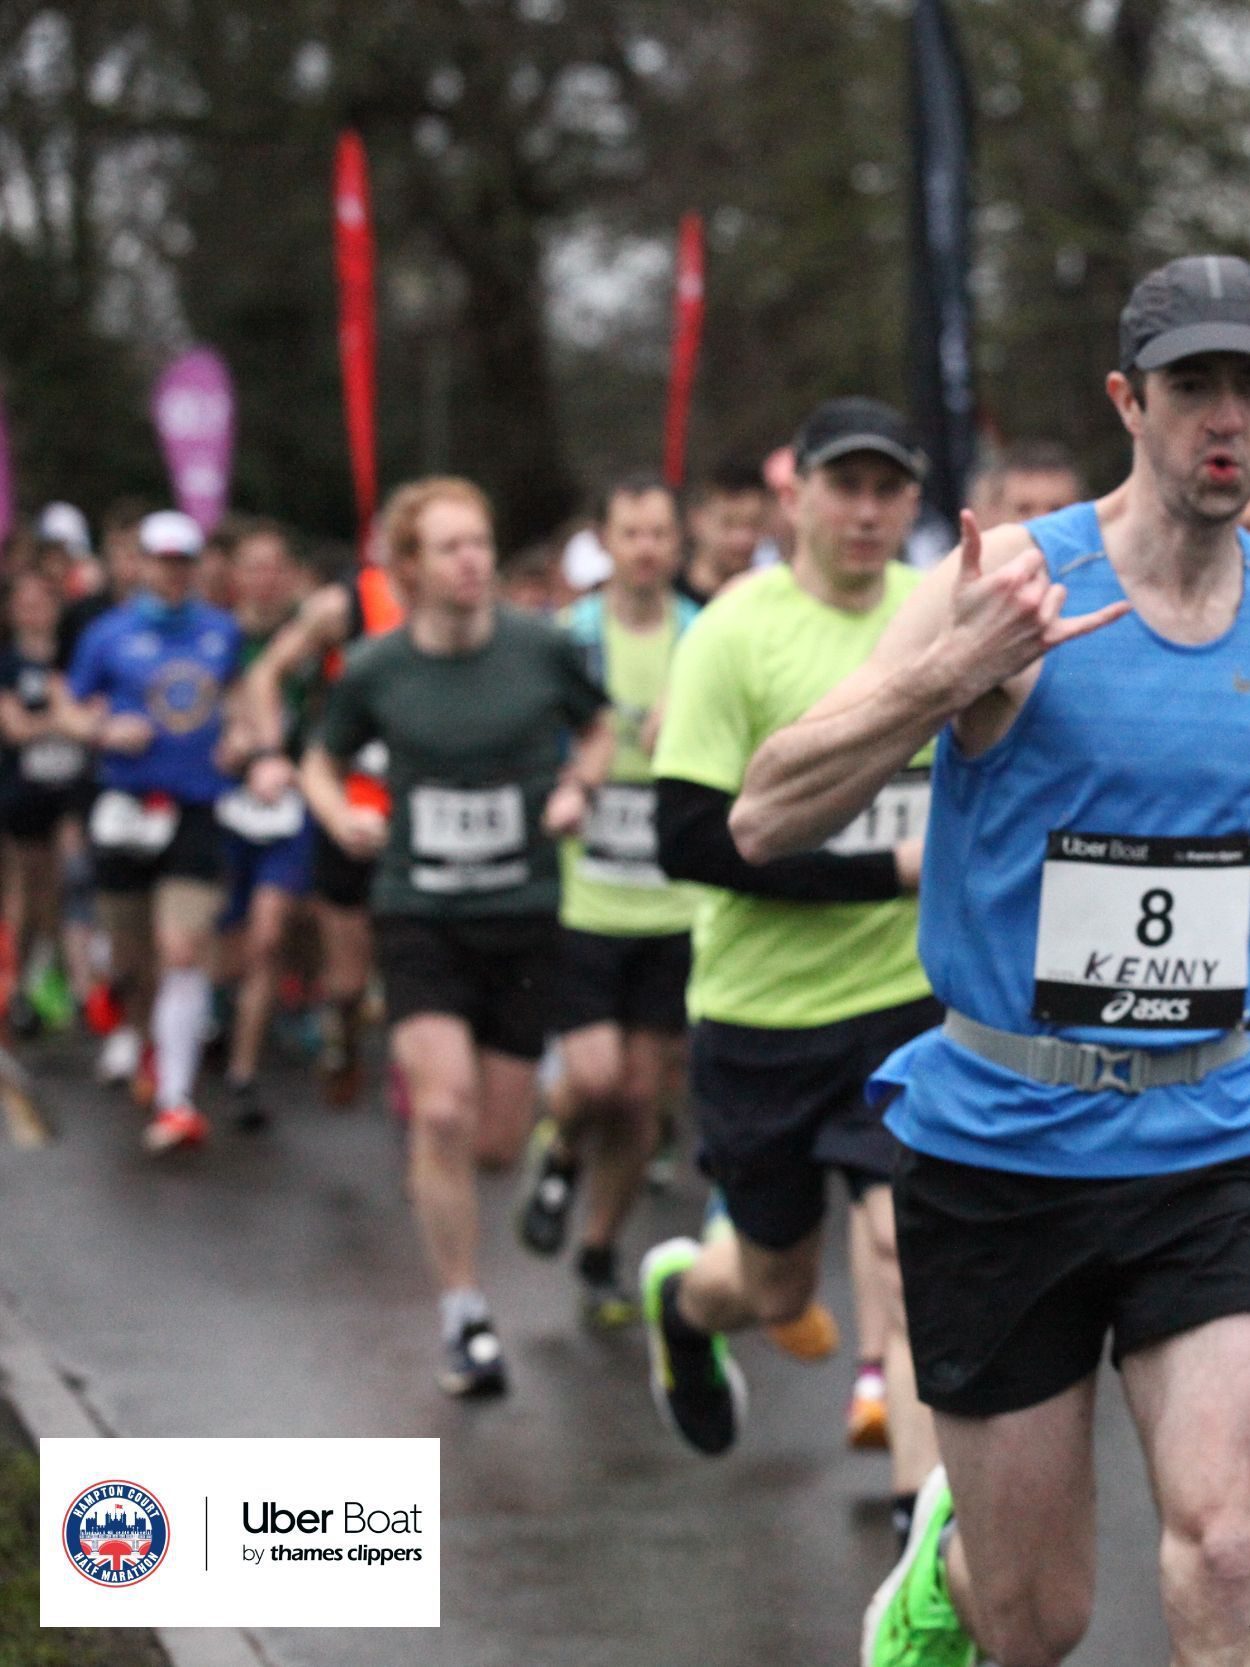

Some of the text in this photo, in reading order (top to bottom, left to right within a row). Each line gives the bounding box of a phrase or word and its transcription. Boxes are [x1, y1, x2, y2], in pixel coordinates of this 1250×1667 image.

[1062, 836, 1107, 857] Uber
[1109, 840, 1149, 861] Boat
[1136, 887, 1174, 947] 8
[1083, 951, 1219, 985] KENNY
